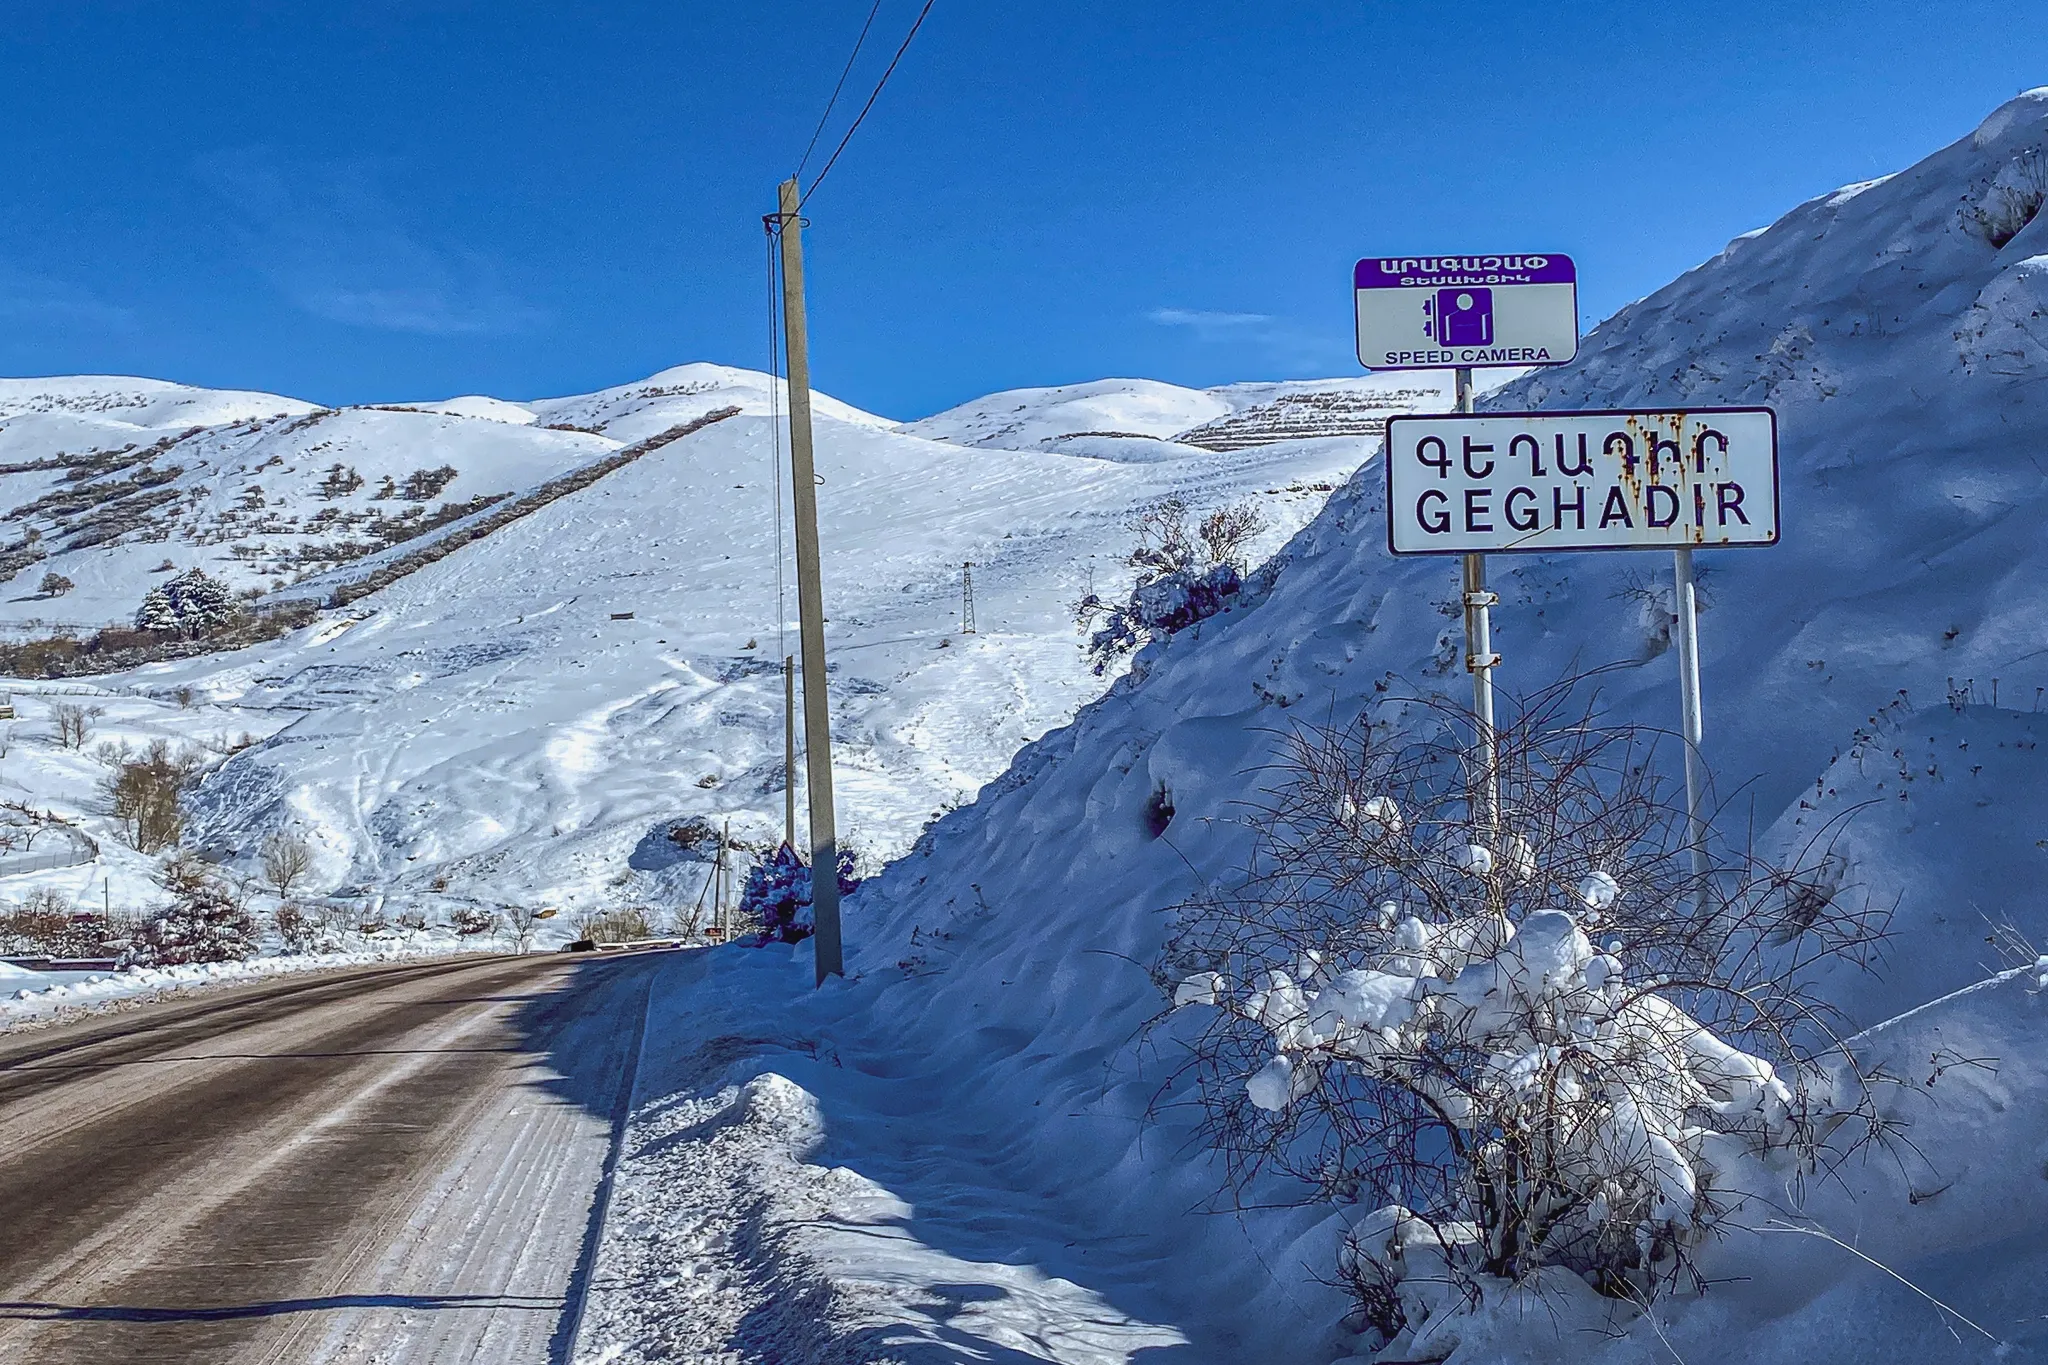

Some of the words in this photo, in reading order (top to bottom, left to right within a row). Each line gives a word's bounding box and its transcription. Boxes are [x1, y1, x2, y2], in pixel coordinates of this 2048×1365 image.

[1380, 256, 1548, 274] ԱՐԱԳԱՉԱՓ
[1385, 350, 1454, 365] SPEED
[1460, 347, 1551, 362] CAMERA
[1415, 429, 1728, 479] ԳԵՂԱԴԻՐ
[1415, 482, 1751, 534] GEGHADIR
